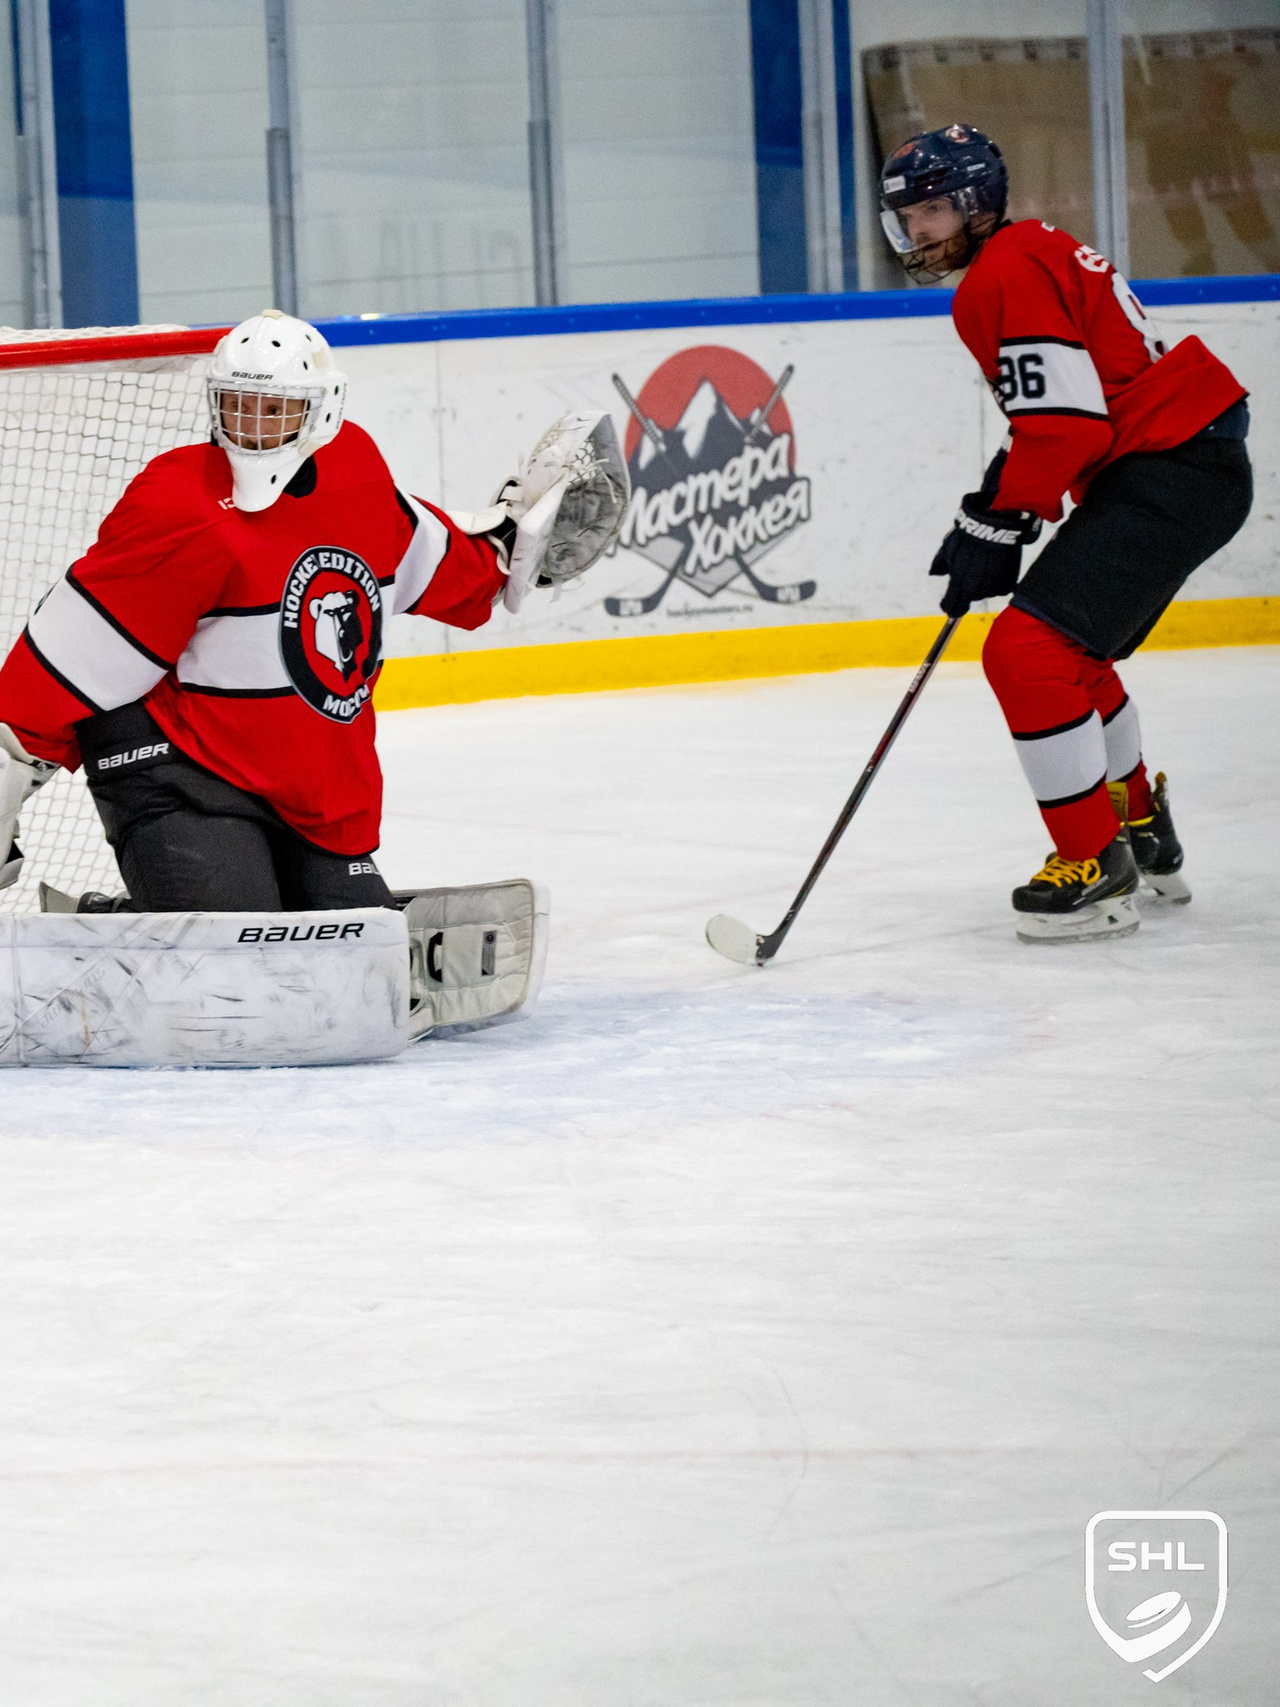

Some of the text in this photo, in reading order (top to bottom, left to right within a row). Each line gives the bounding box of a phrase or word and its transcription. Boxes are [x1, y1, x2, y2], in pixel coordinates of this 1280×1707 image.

[230, 370, 274, 381] BAUER
[683, 478, 809, 577] Хоккея
[283, 552, 381, 629] HOCKE EDITION
[98, 742, 170, 771] BAUER
[237, 922, 365, 943] BAUER
